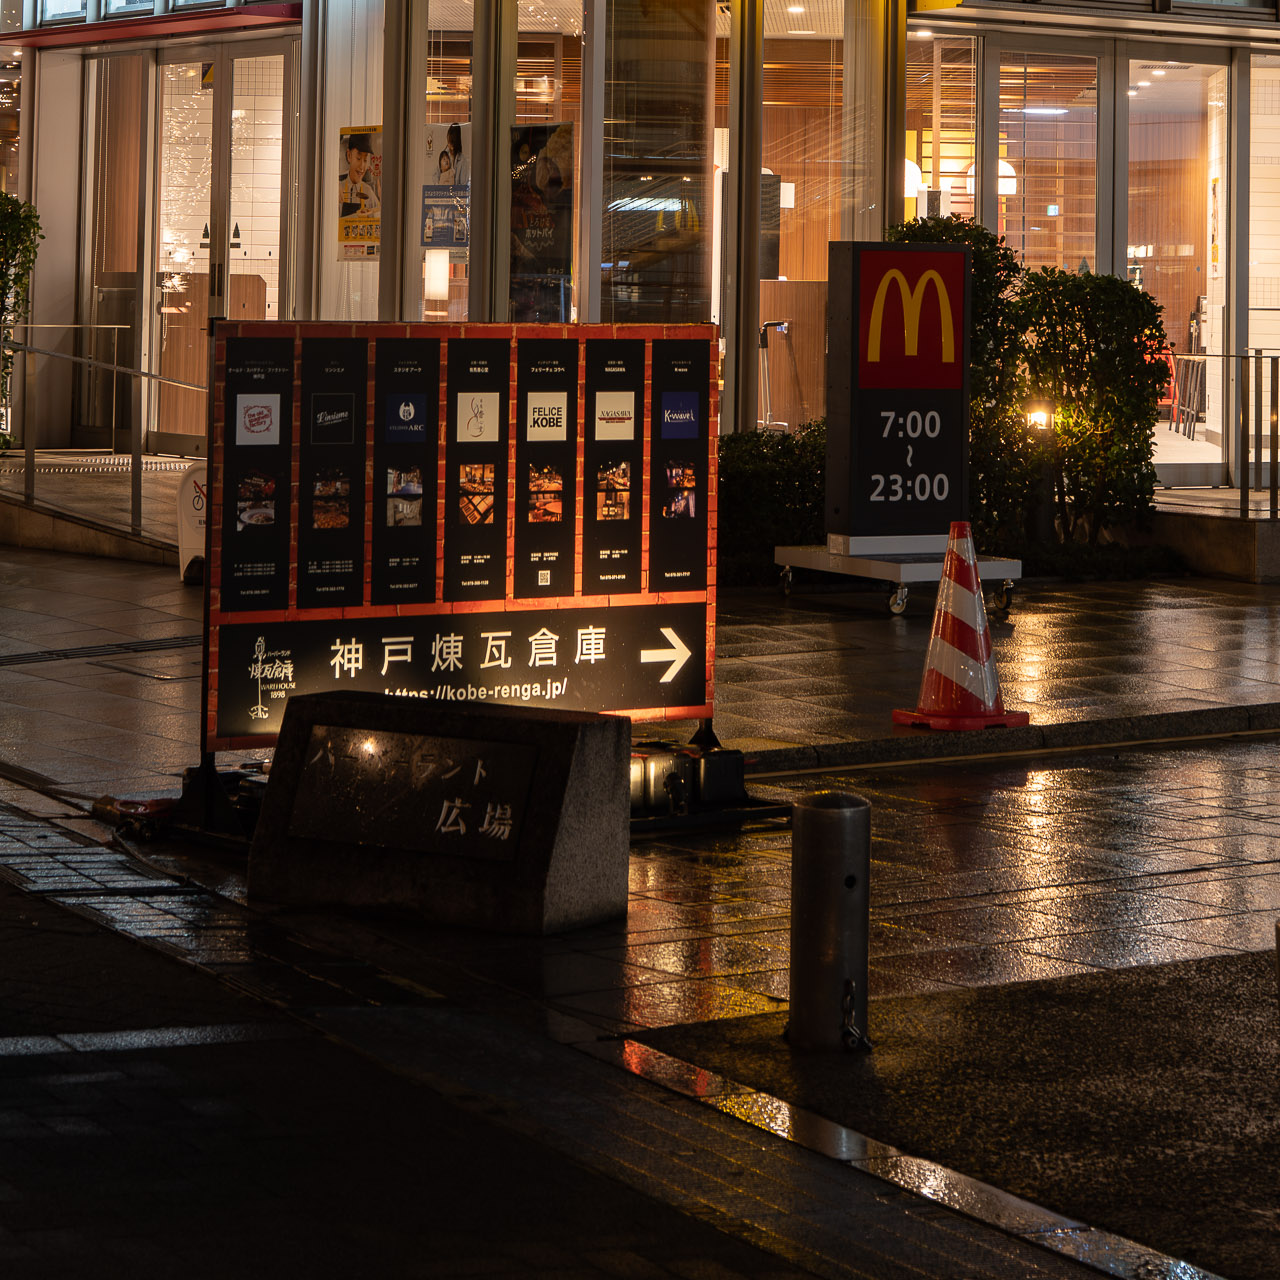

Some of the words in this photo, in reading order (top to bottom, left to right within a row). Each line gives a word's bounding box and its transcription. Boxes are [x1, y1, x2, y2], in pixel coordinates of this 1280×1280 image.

[529, 417, 563, 428] .KOBE
[532, 406, 563, 417] FELICE
[880, 410, 941, 438] 7:00
[870, 473, 949, 501] 23:00
[330, 625, 606, 679] 神戸煉瓦倉庫
[270, 690, 286, 699] 1898
[433, 796, 514, 842] 広場
